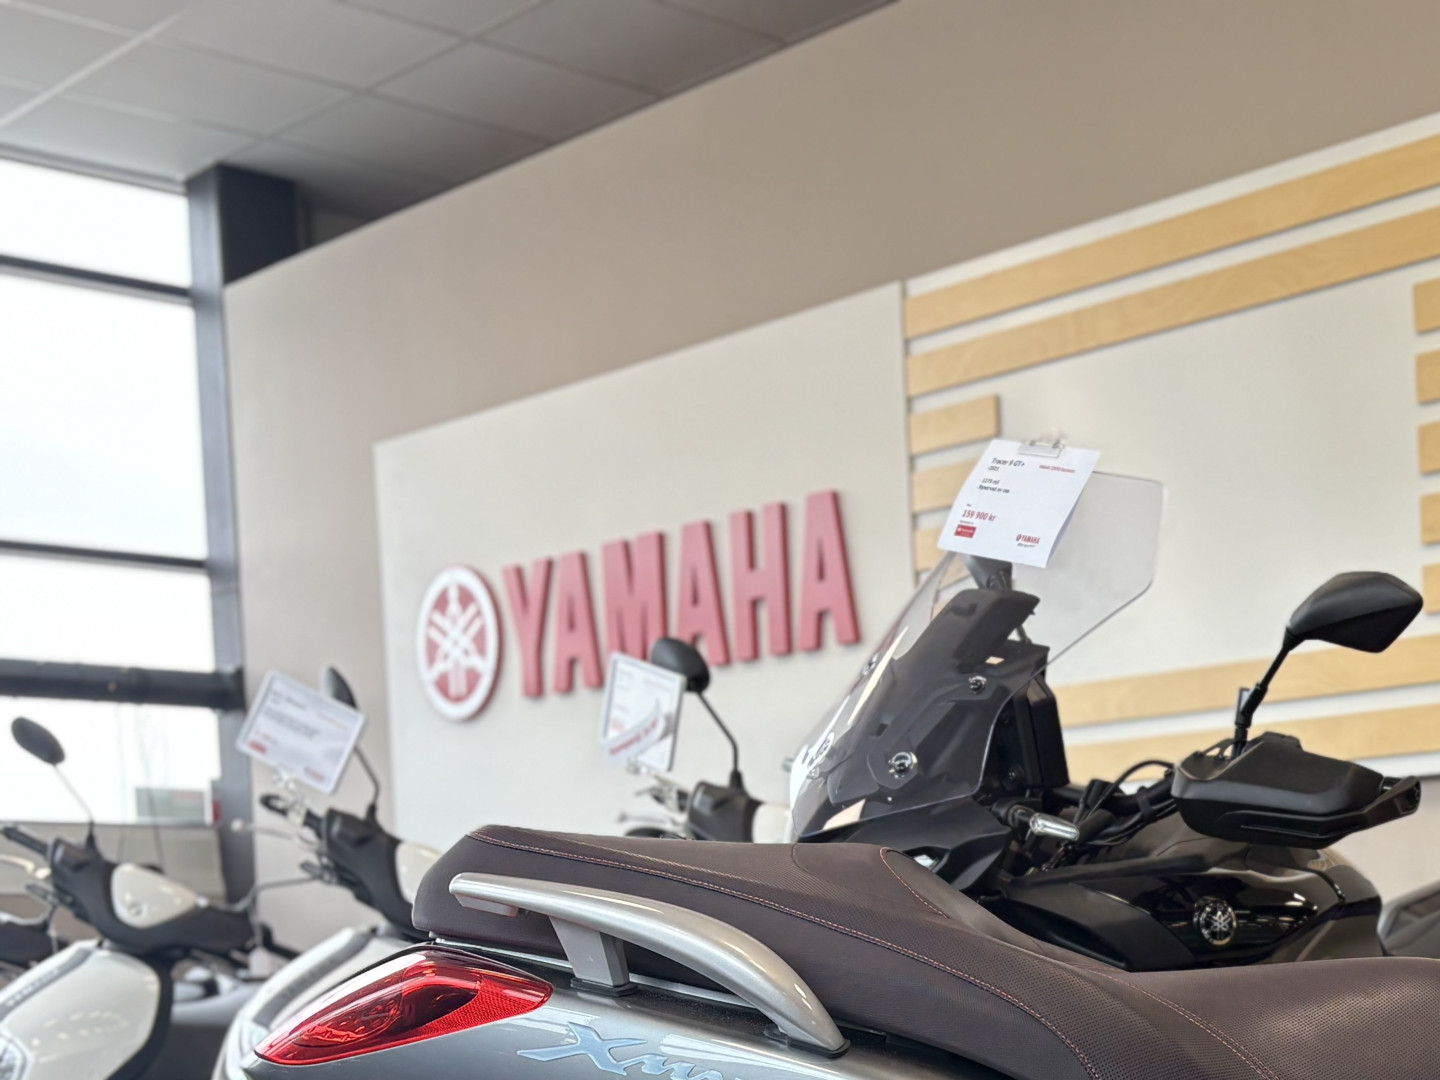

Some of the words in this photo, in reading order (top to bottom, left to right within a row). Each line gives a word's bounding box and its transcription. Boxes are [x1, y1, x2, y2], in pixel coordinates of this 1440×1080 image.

[992, 457, 1009, 466] Tracer
[1013, 460, 1025, 468] GT+
[962, 509, 976, 519] 159
[975, 511, 989, 521] 900
[988, 513, 996, 521] kr
[1021, 535, 1040, 544] YAMAHA
[501, 489, 861, 698] YAMAHA
